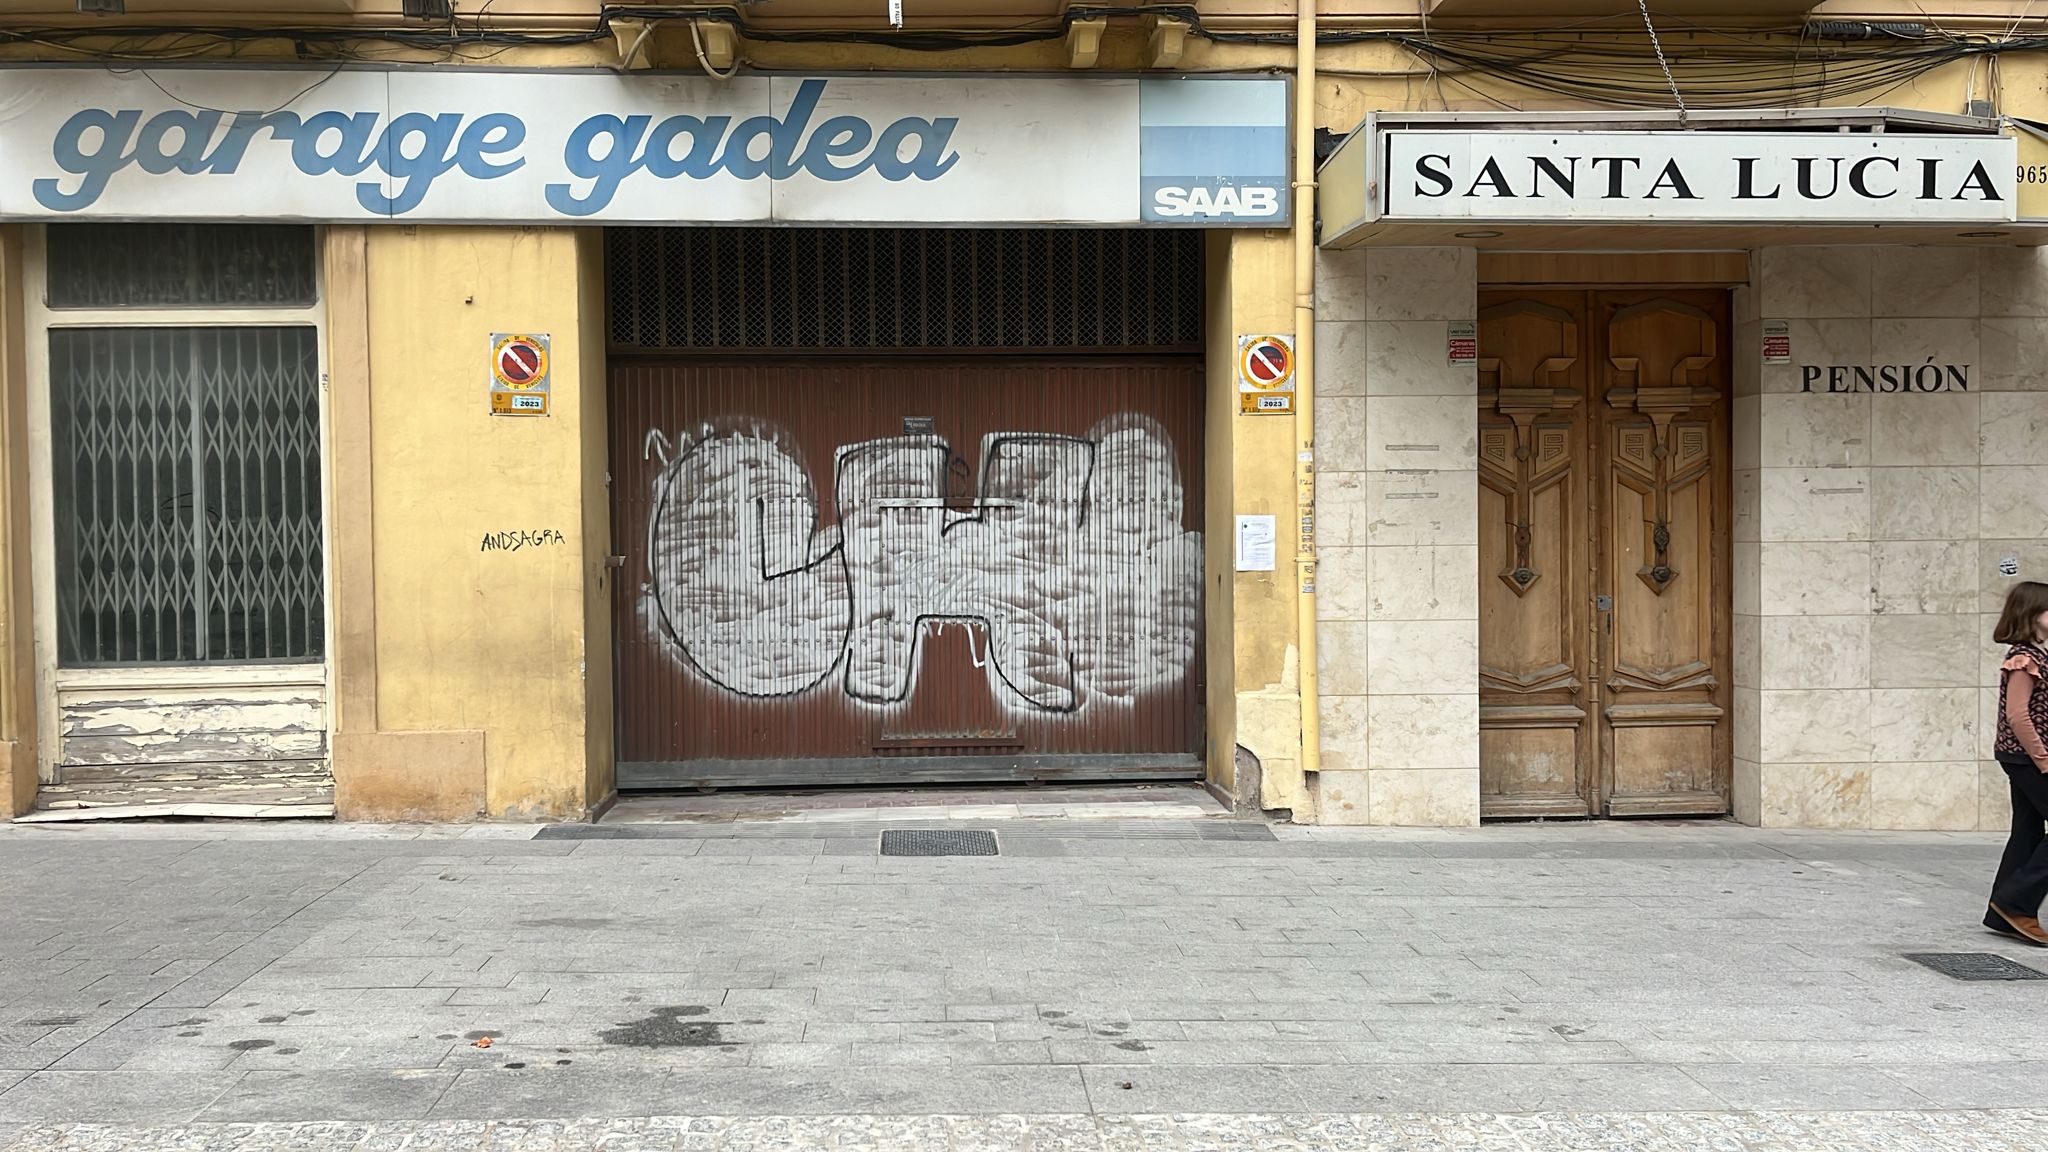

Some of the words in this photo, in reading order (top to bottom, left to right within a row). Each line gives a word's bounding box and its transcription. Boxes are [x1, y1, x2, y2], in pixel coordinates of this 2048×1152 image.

[33, 108, 527, 213] garage
[545, 79, 959, 217] gadea
[1414, 154, 1704, 199] SANTA
[1732, 156, 2005, 201] LUCIA
[1153, 186, 1279, 217] SAAB
[1800, 355, 1970, 394] PENSIÓN
[481, 529, 566, 552] ANDSAGRA
